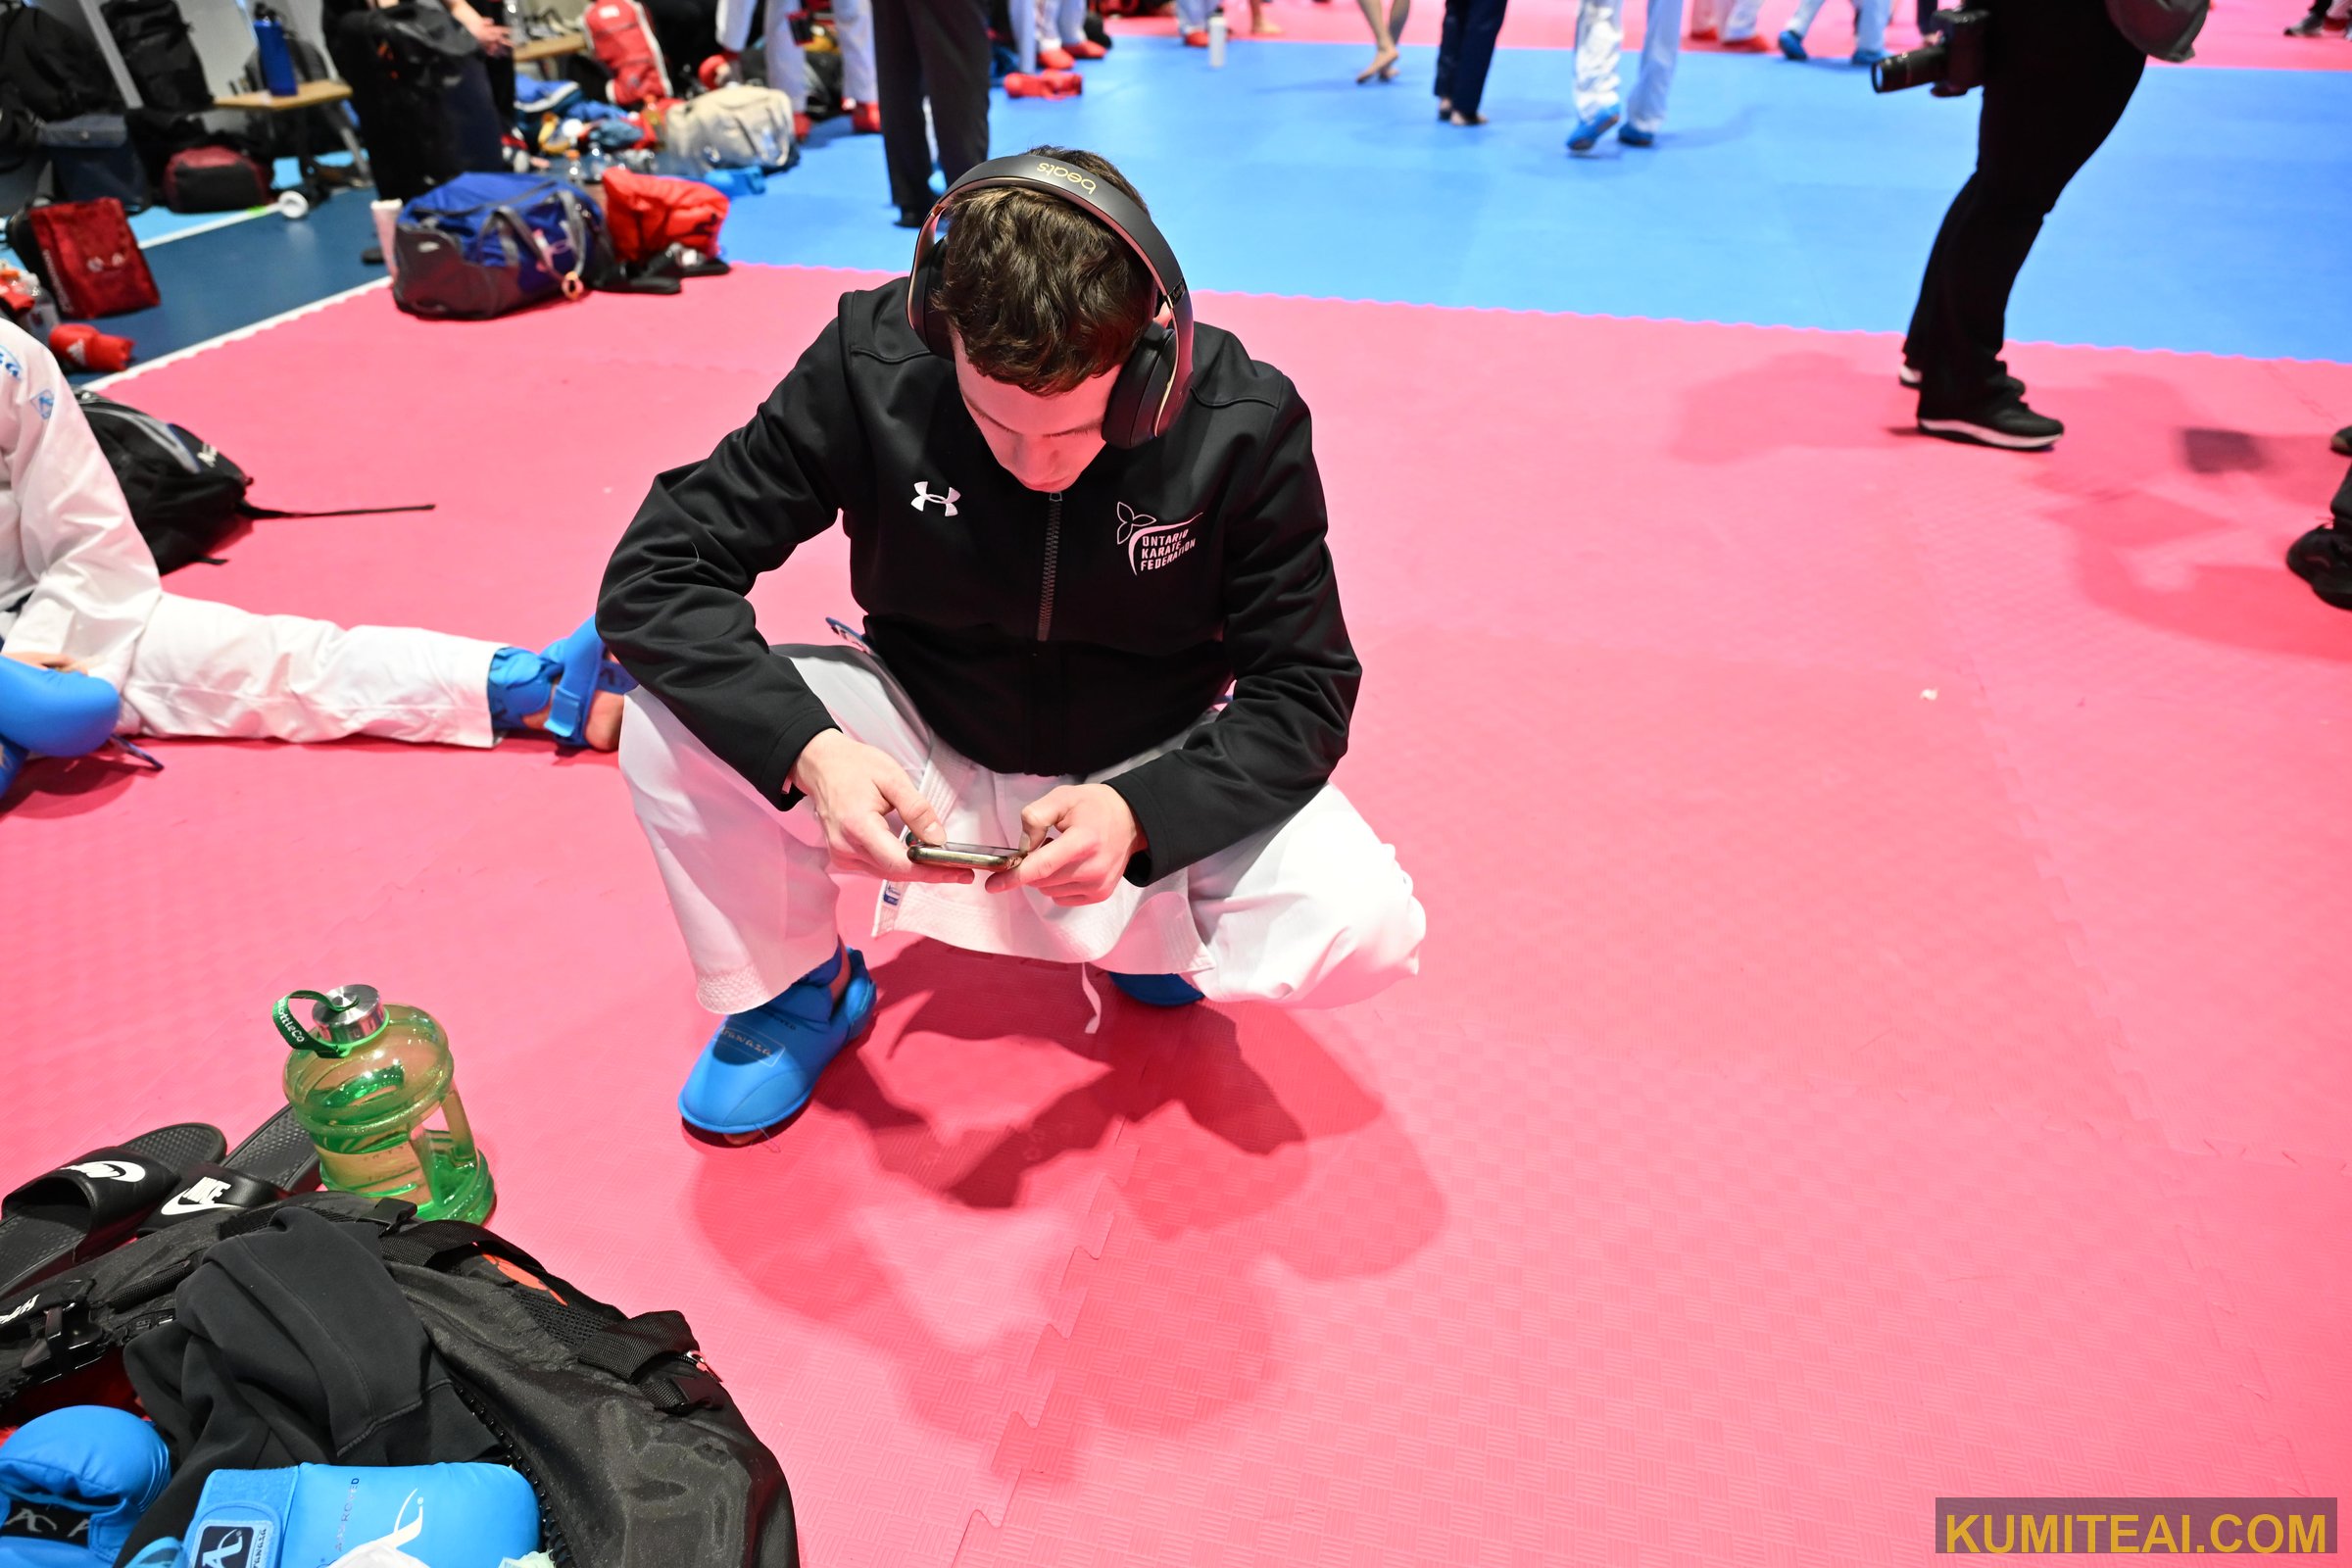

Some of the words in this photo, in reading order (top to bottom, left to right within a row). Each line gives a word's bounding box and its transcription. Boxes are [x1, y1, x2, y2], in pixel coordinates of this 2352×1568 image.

[1036, 162, 1097, 195] beats
[1141, 540, 1182, 560] KARATE
[1142, 529, 1189, 547] ONTARIO
[1140, 538, 1196, 571] FEDERATION
